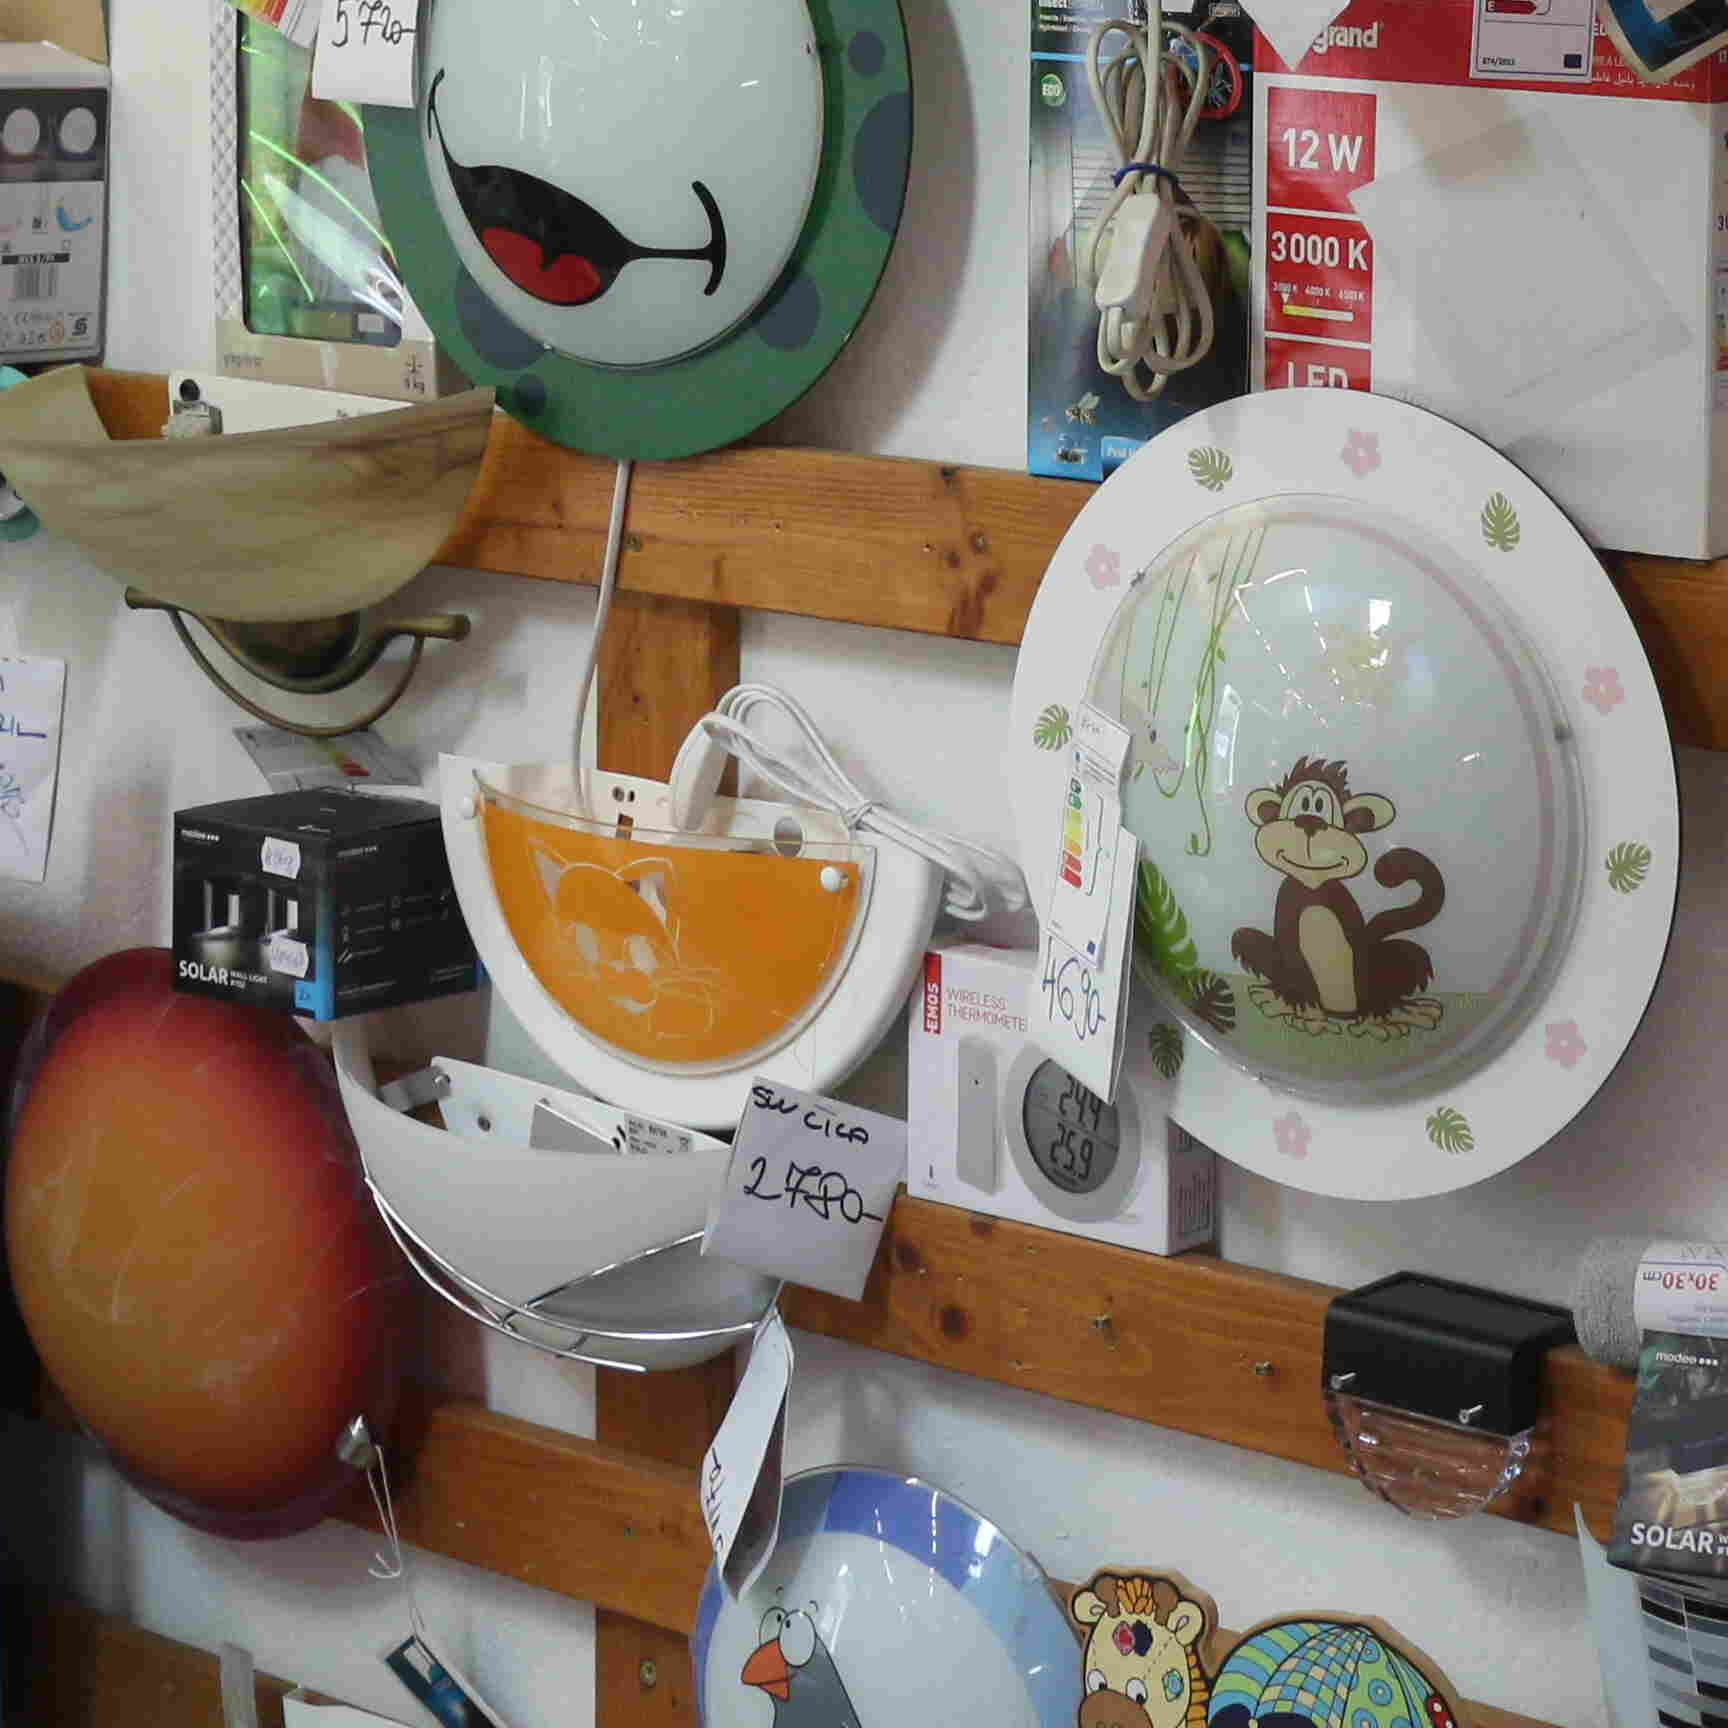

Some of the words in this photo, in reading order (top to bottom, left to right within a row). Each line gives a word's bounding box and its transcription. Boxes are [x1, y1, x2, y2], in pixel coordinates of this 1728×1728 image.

[1311, 22, 1379, 54] grand
[1282, 128, 1320, 170] 12
[1328, 134, 1363, 173] W
[1272, 231, 1340, 268] 3000
[1349, 238, 1369, 271] K
[179, 959, 230, 986] SOLAR
[927, 983, 939, 1034] EMOS
[946, 987, 1008, 1011] WIRELESS
[947, 1004, 1027, 1032] THERMOMETE
[1631, 1522, 1714, 1556] SOLAR
